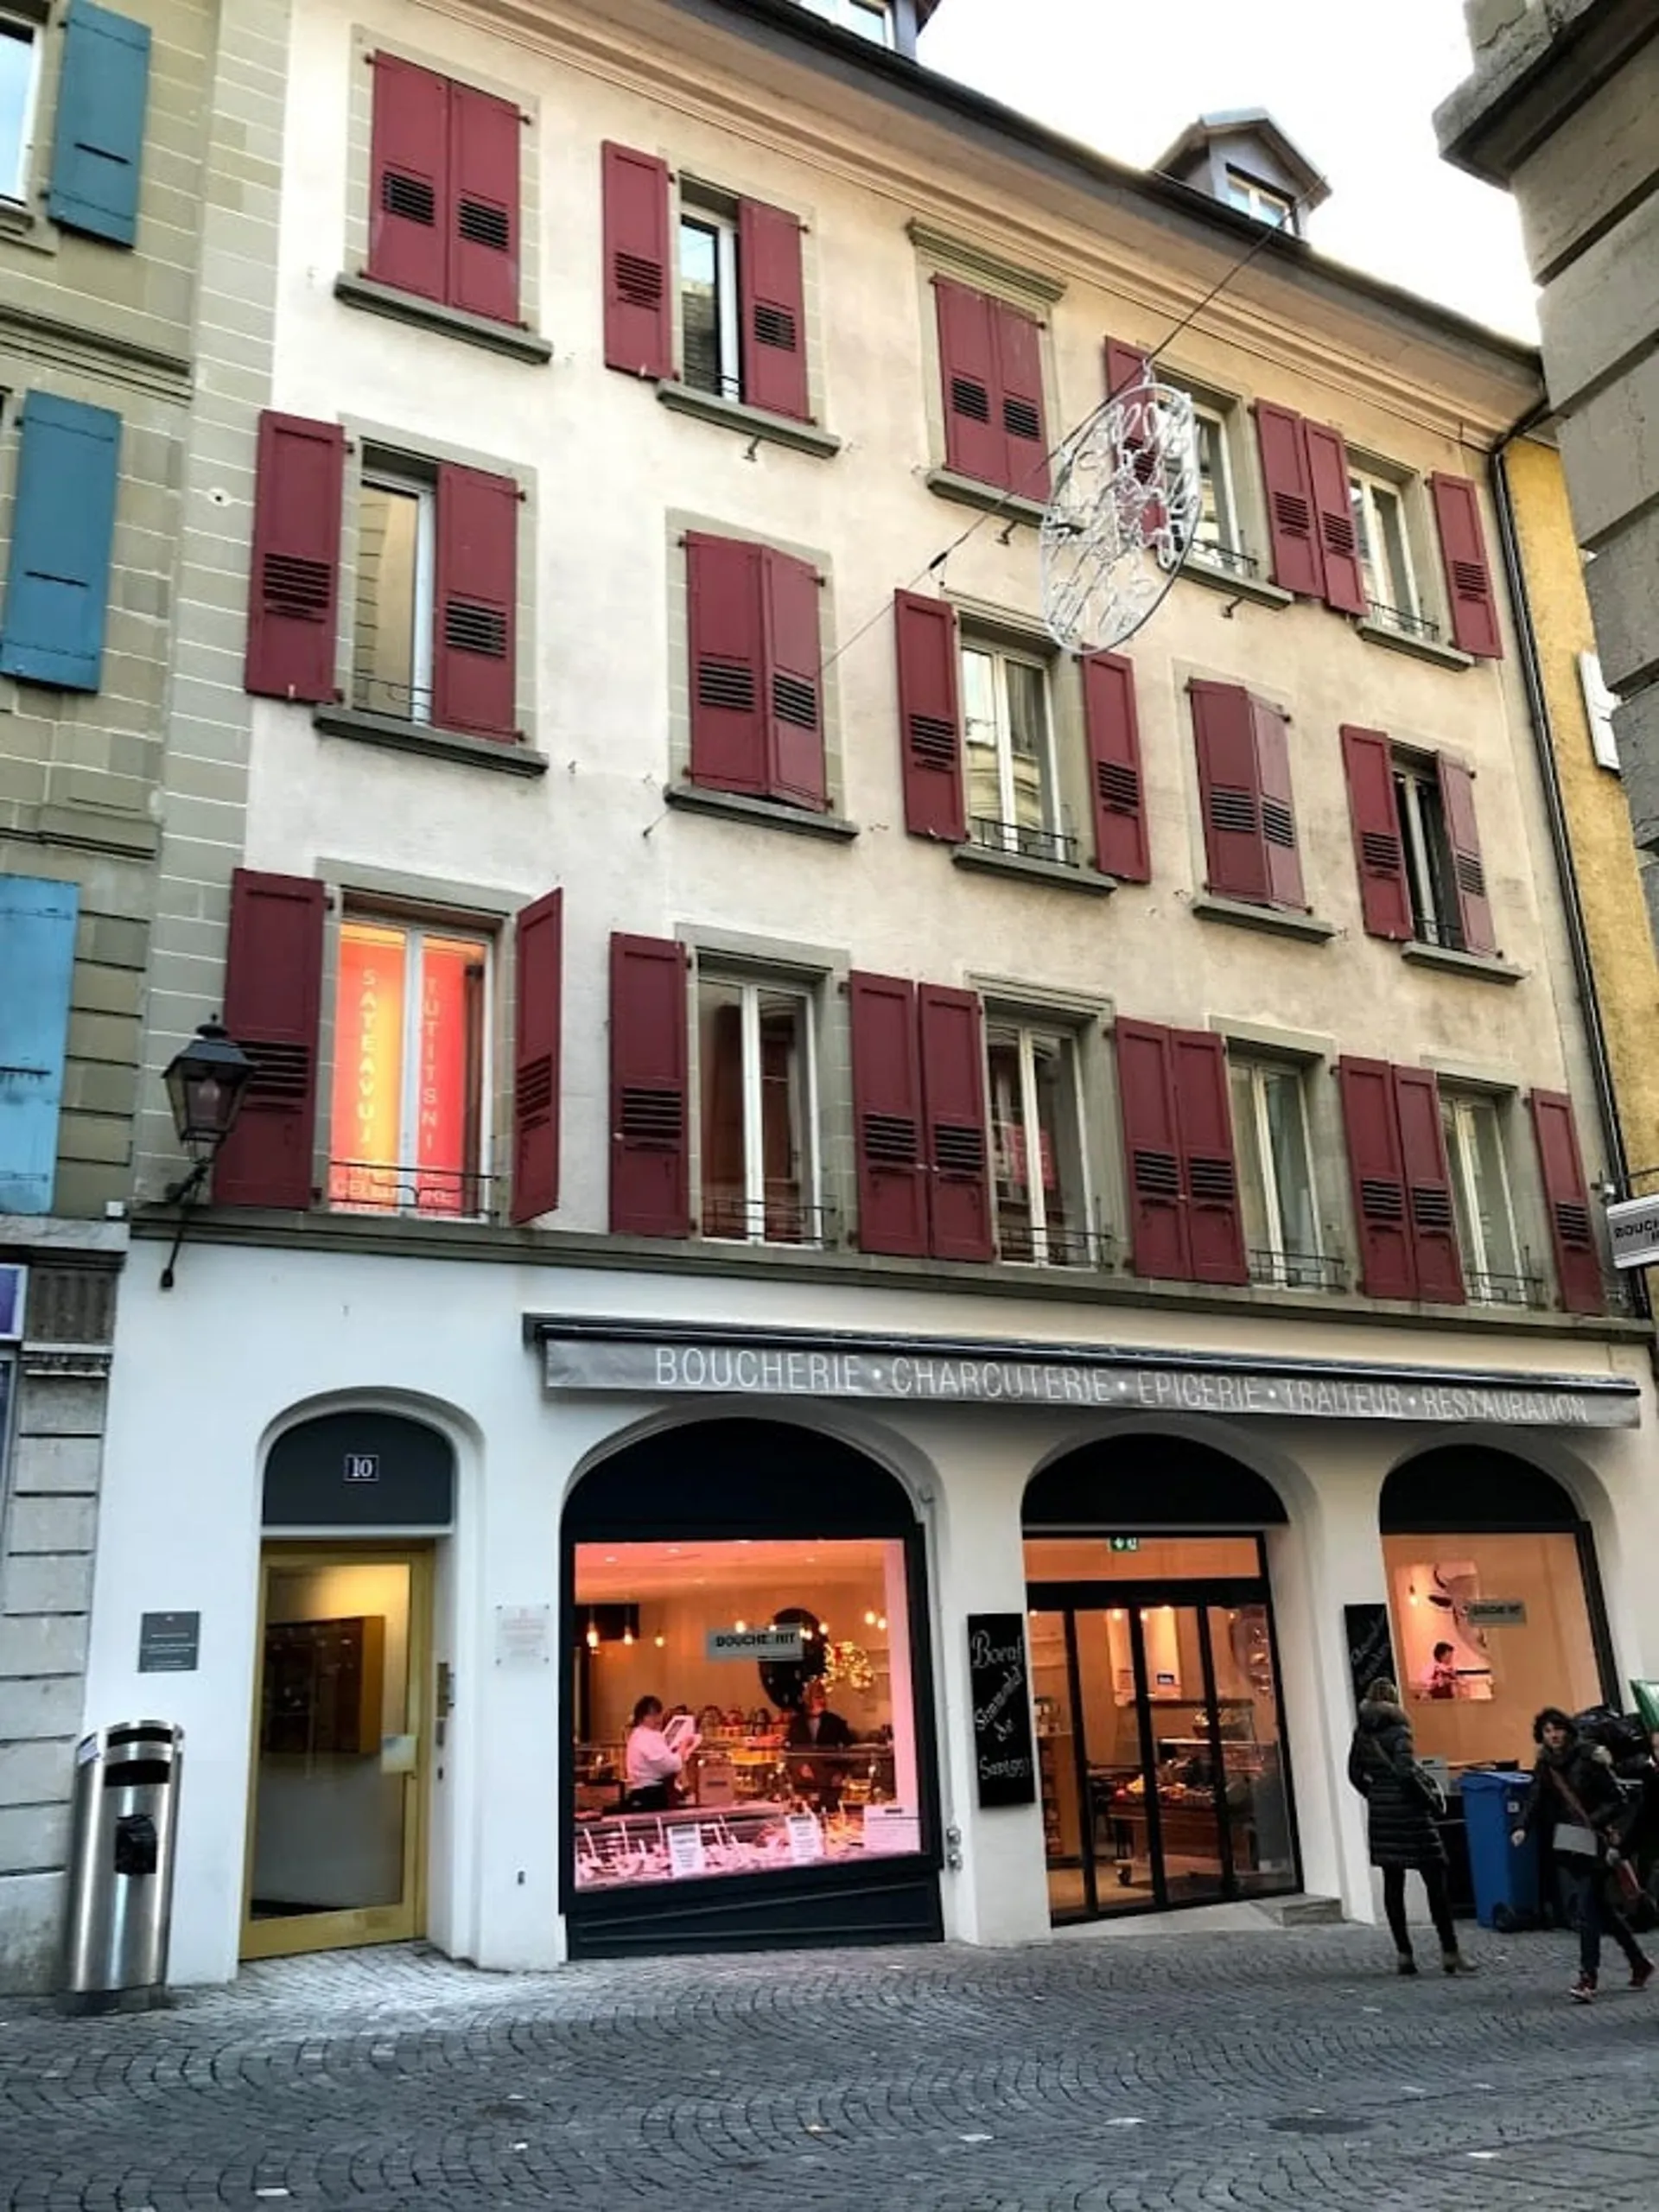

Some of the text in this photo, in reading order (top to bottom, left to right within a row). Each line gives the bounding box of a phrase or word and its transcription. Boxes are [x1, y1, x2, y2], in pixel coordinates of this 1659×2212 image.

[655, 1347, 1590, 1424] BOUCHERIE CHARCUTERIE EPICERIE TRAITEUR RESTAURATION
[352, 1458, 372, 1478] 10
